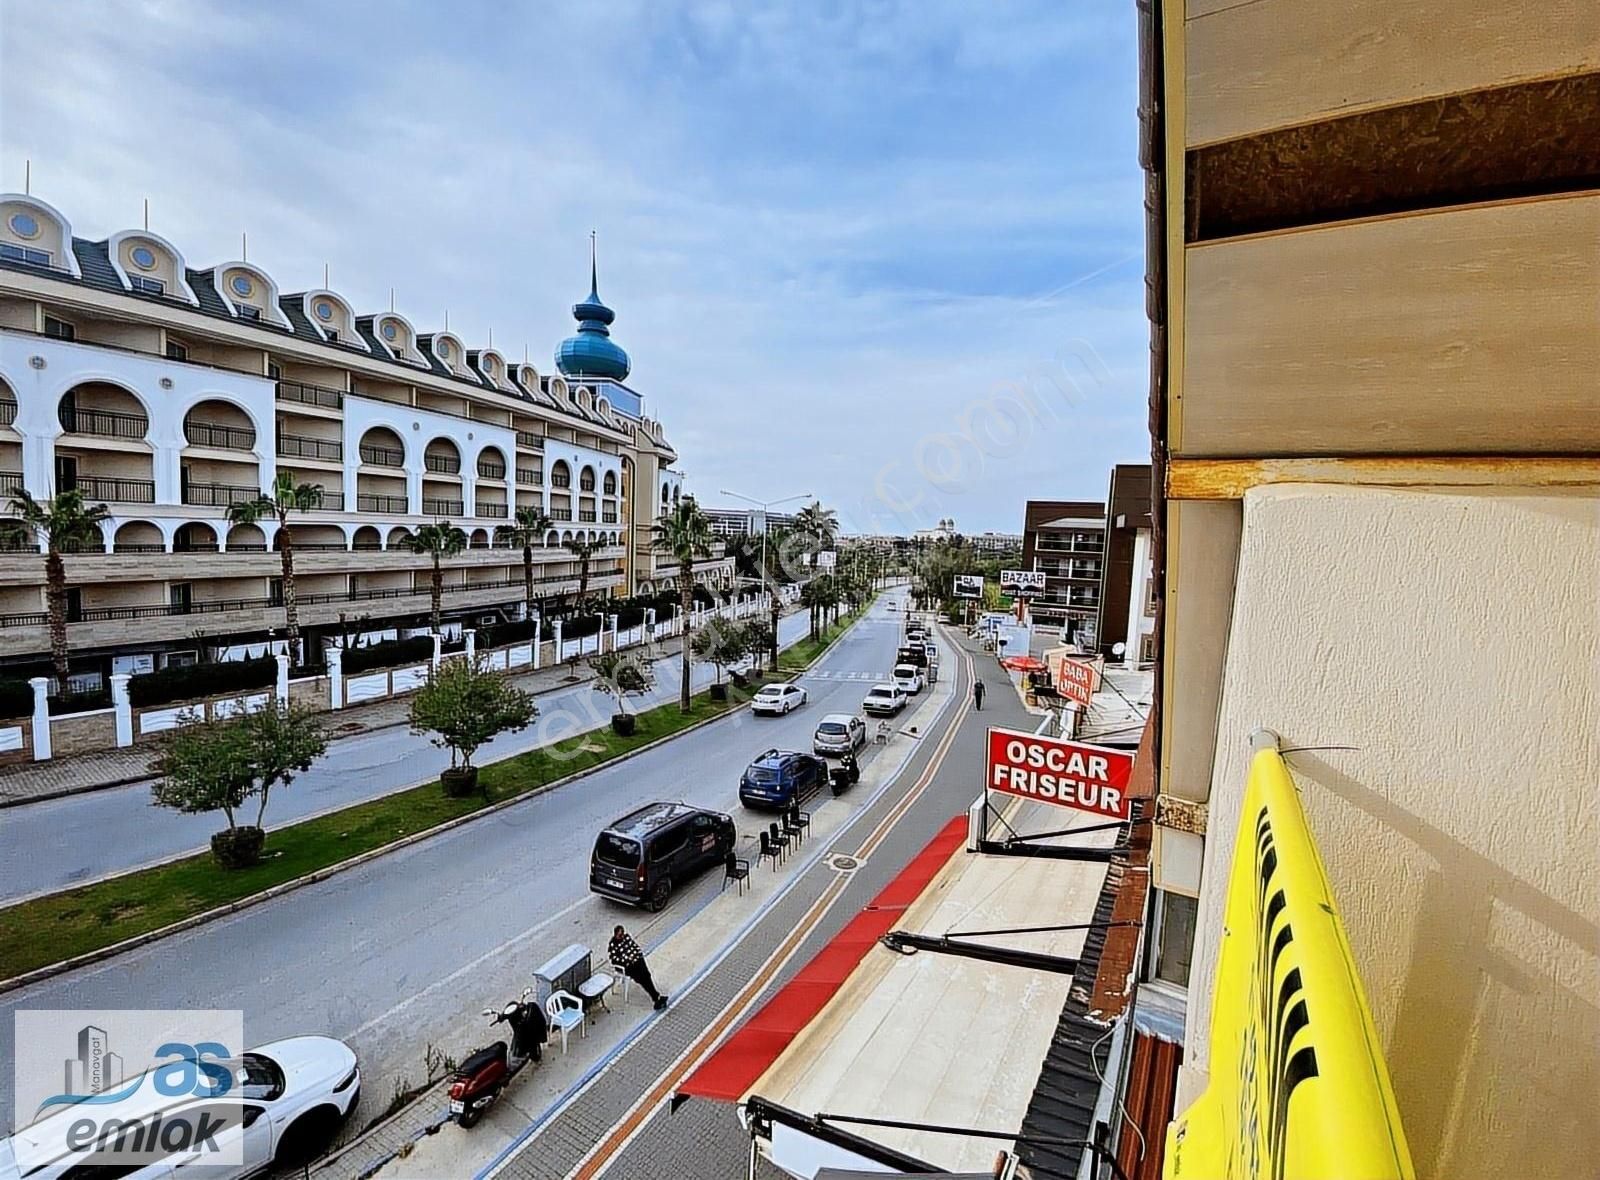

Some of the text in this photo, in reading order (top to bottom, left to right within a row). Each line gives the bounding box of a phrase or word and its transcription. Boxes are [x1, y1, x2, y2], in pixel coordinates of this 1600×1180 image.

[1002, 572, 1044, 585] BAZAAR
[1063, 662, 1088, 684] BABA
[1006, 740, 1109, 782] OSCAR
[993, 764, 1121, 813] FRISEUR
